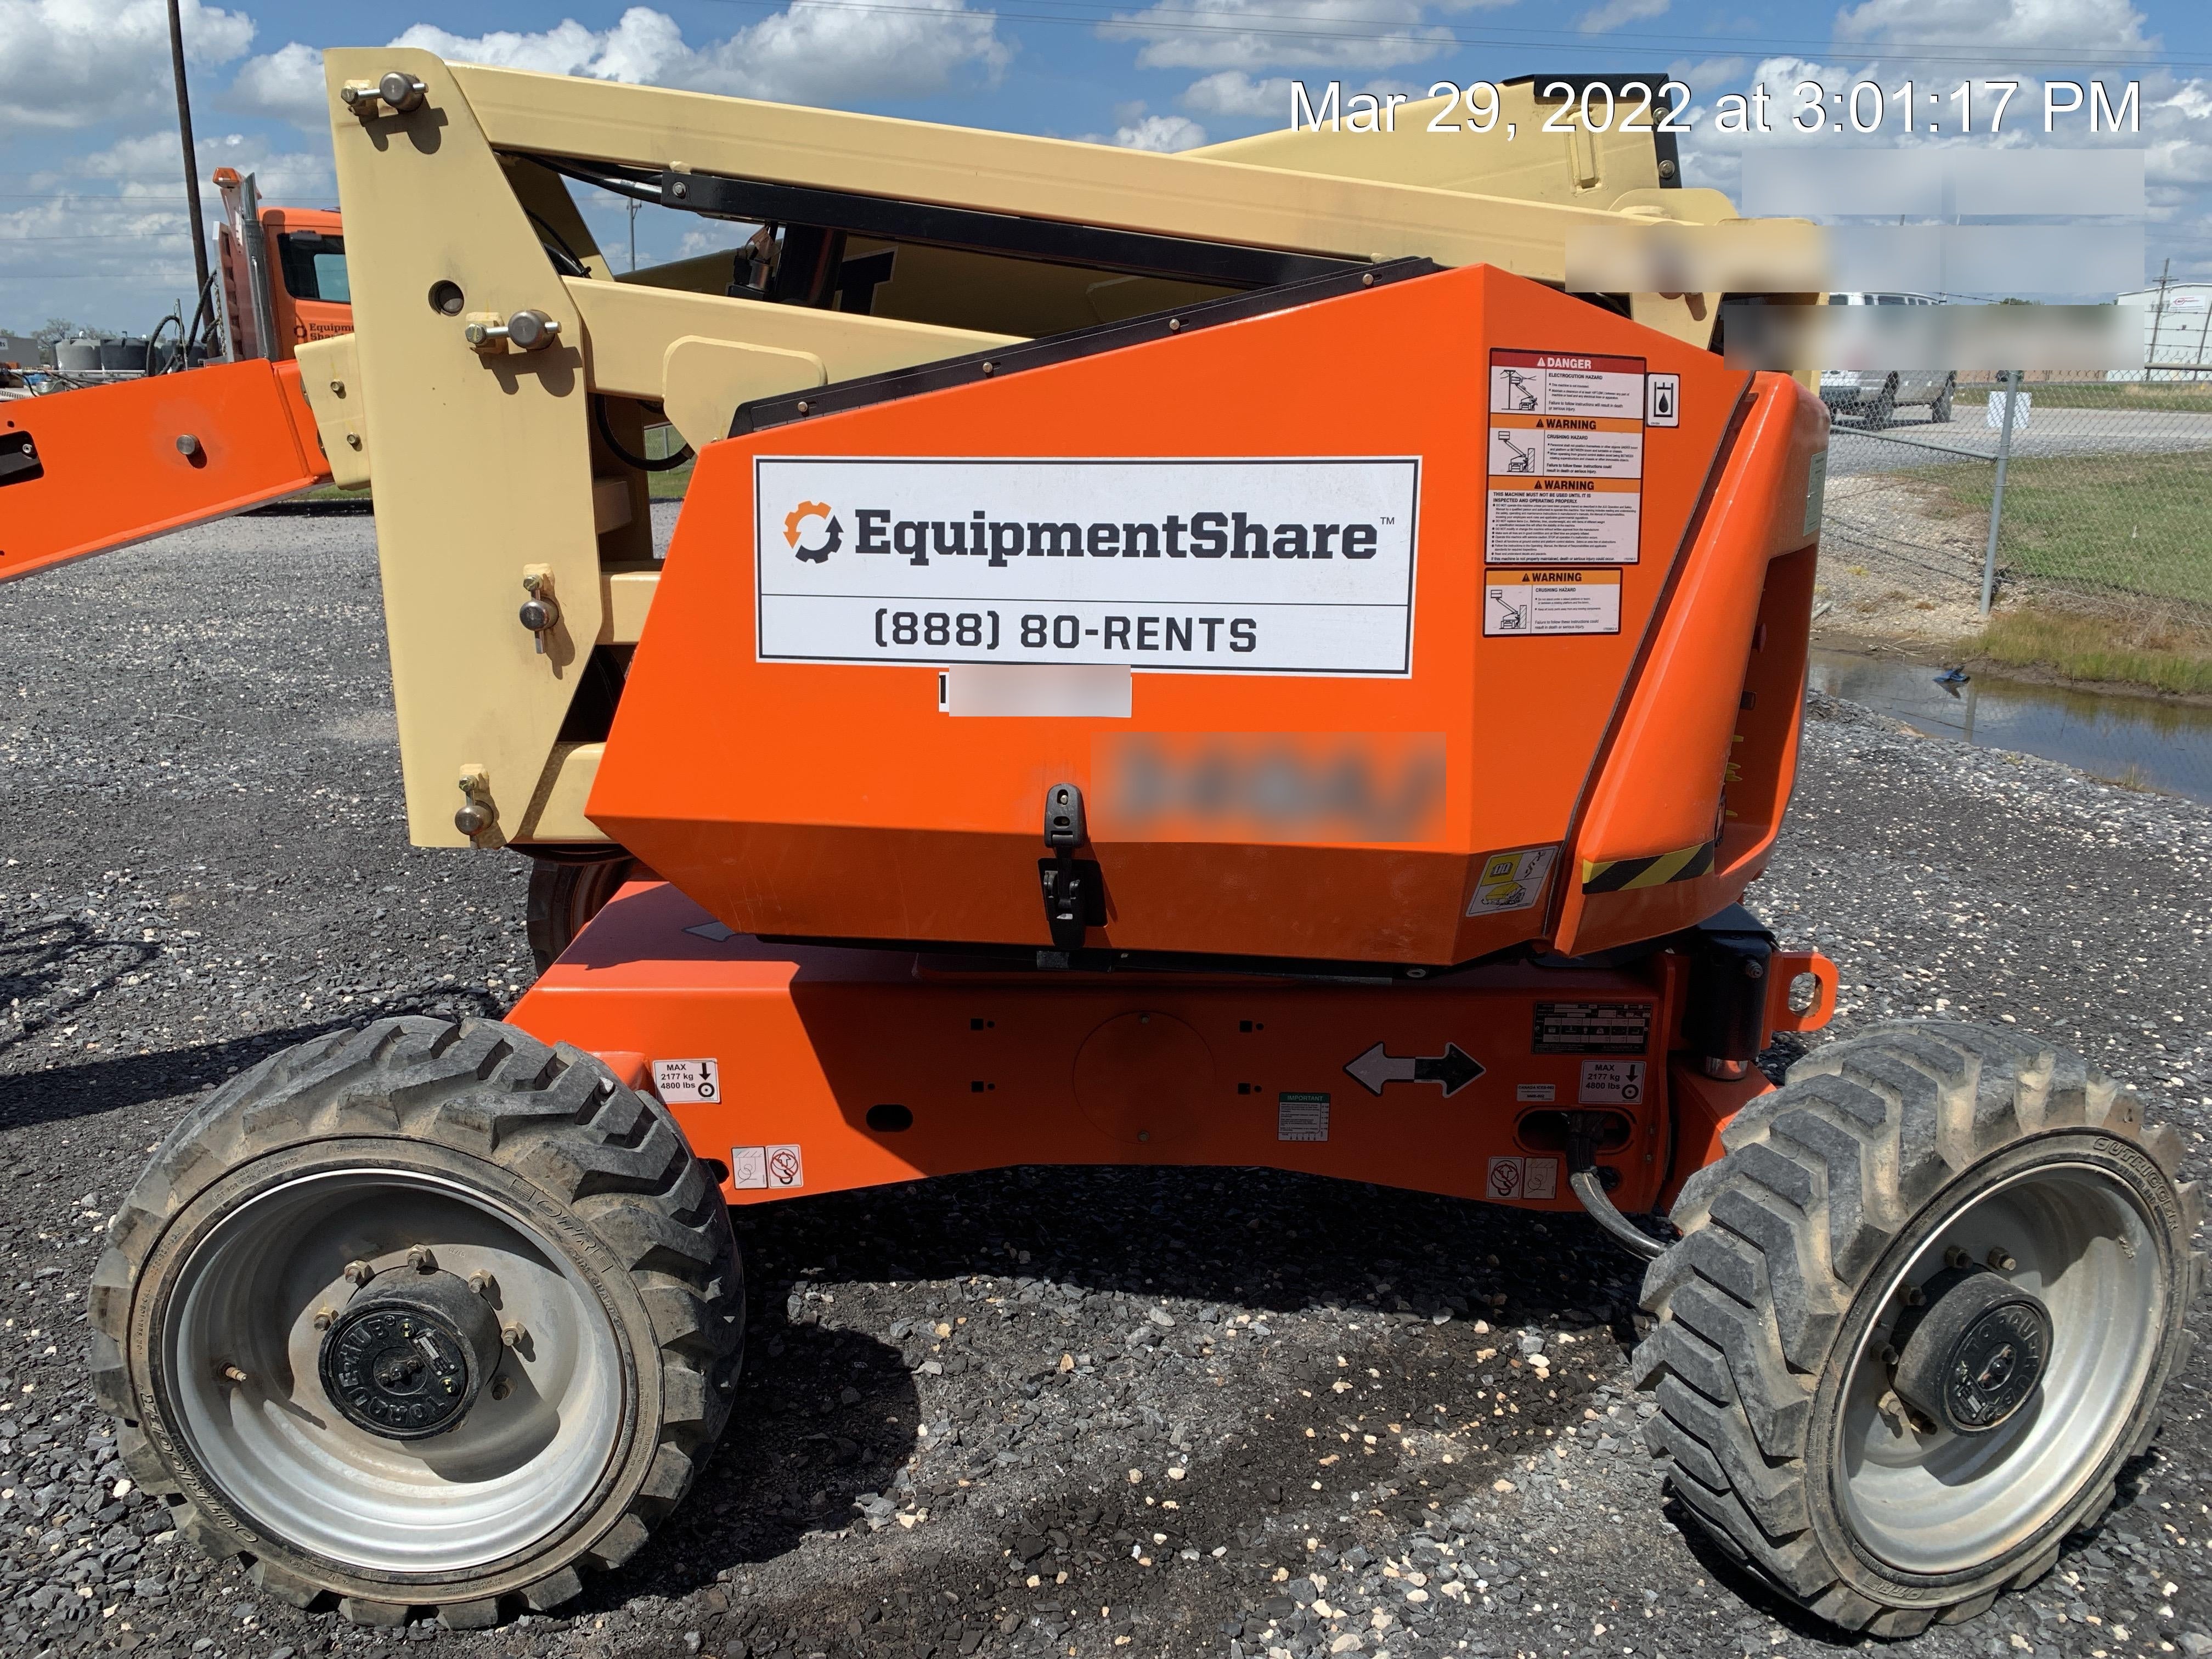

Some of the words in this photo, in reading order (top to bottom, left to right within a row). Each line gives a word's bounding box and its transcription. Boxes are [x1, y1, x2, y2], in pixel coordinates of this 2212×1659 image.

[1547, 357, 1592, 369] DANGER
[1546, 419, 1596, 430] WARNING
[1544, 480, 1594, 490] WARNING
[855, 509, 1377, 567] EquipmentShare
[1532, 573, 1582, 582] WARNING
[875, 608, 1000, 651] (888)
[1020, 614, 1257, 652] 80-RENTS
[1610, 1074, 1620, 1082] kg
